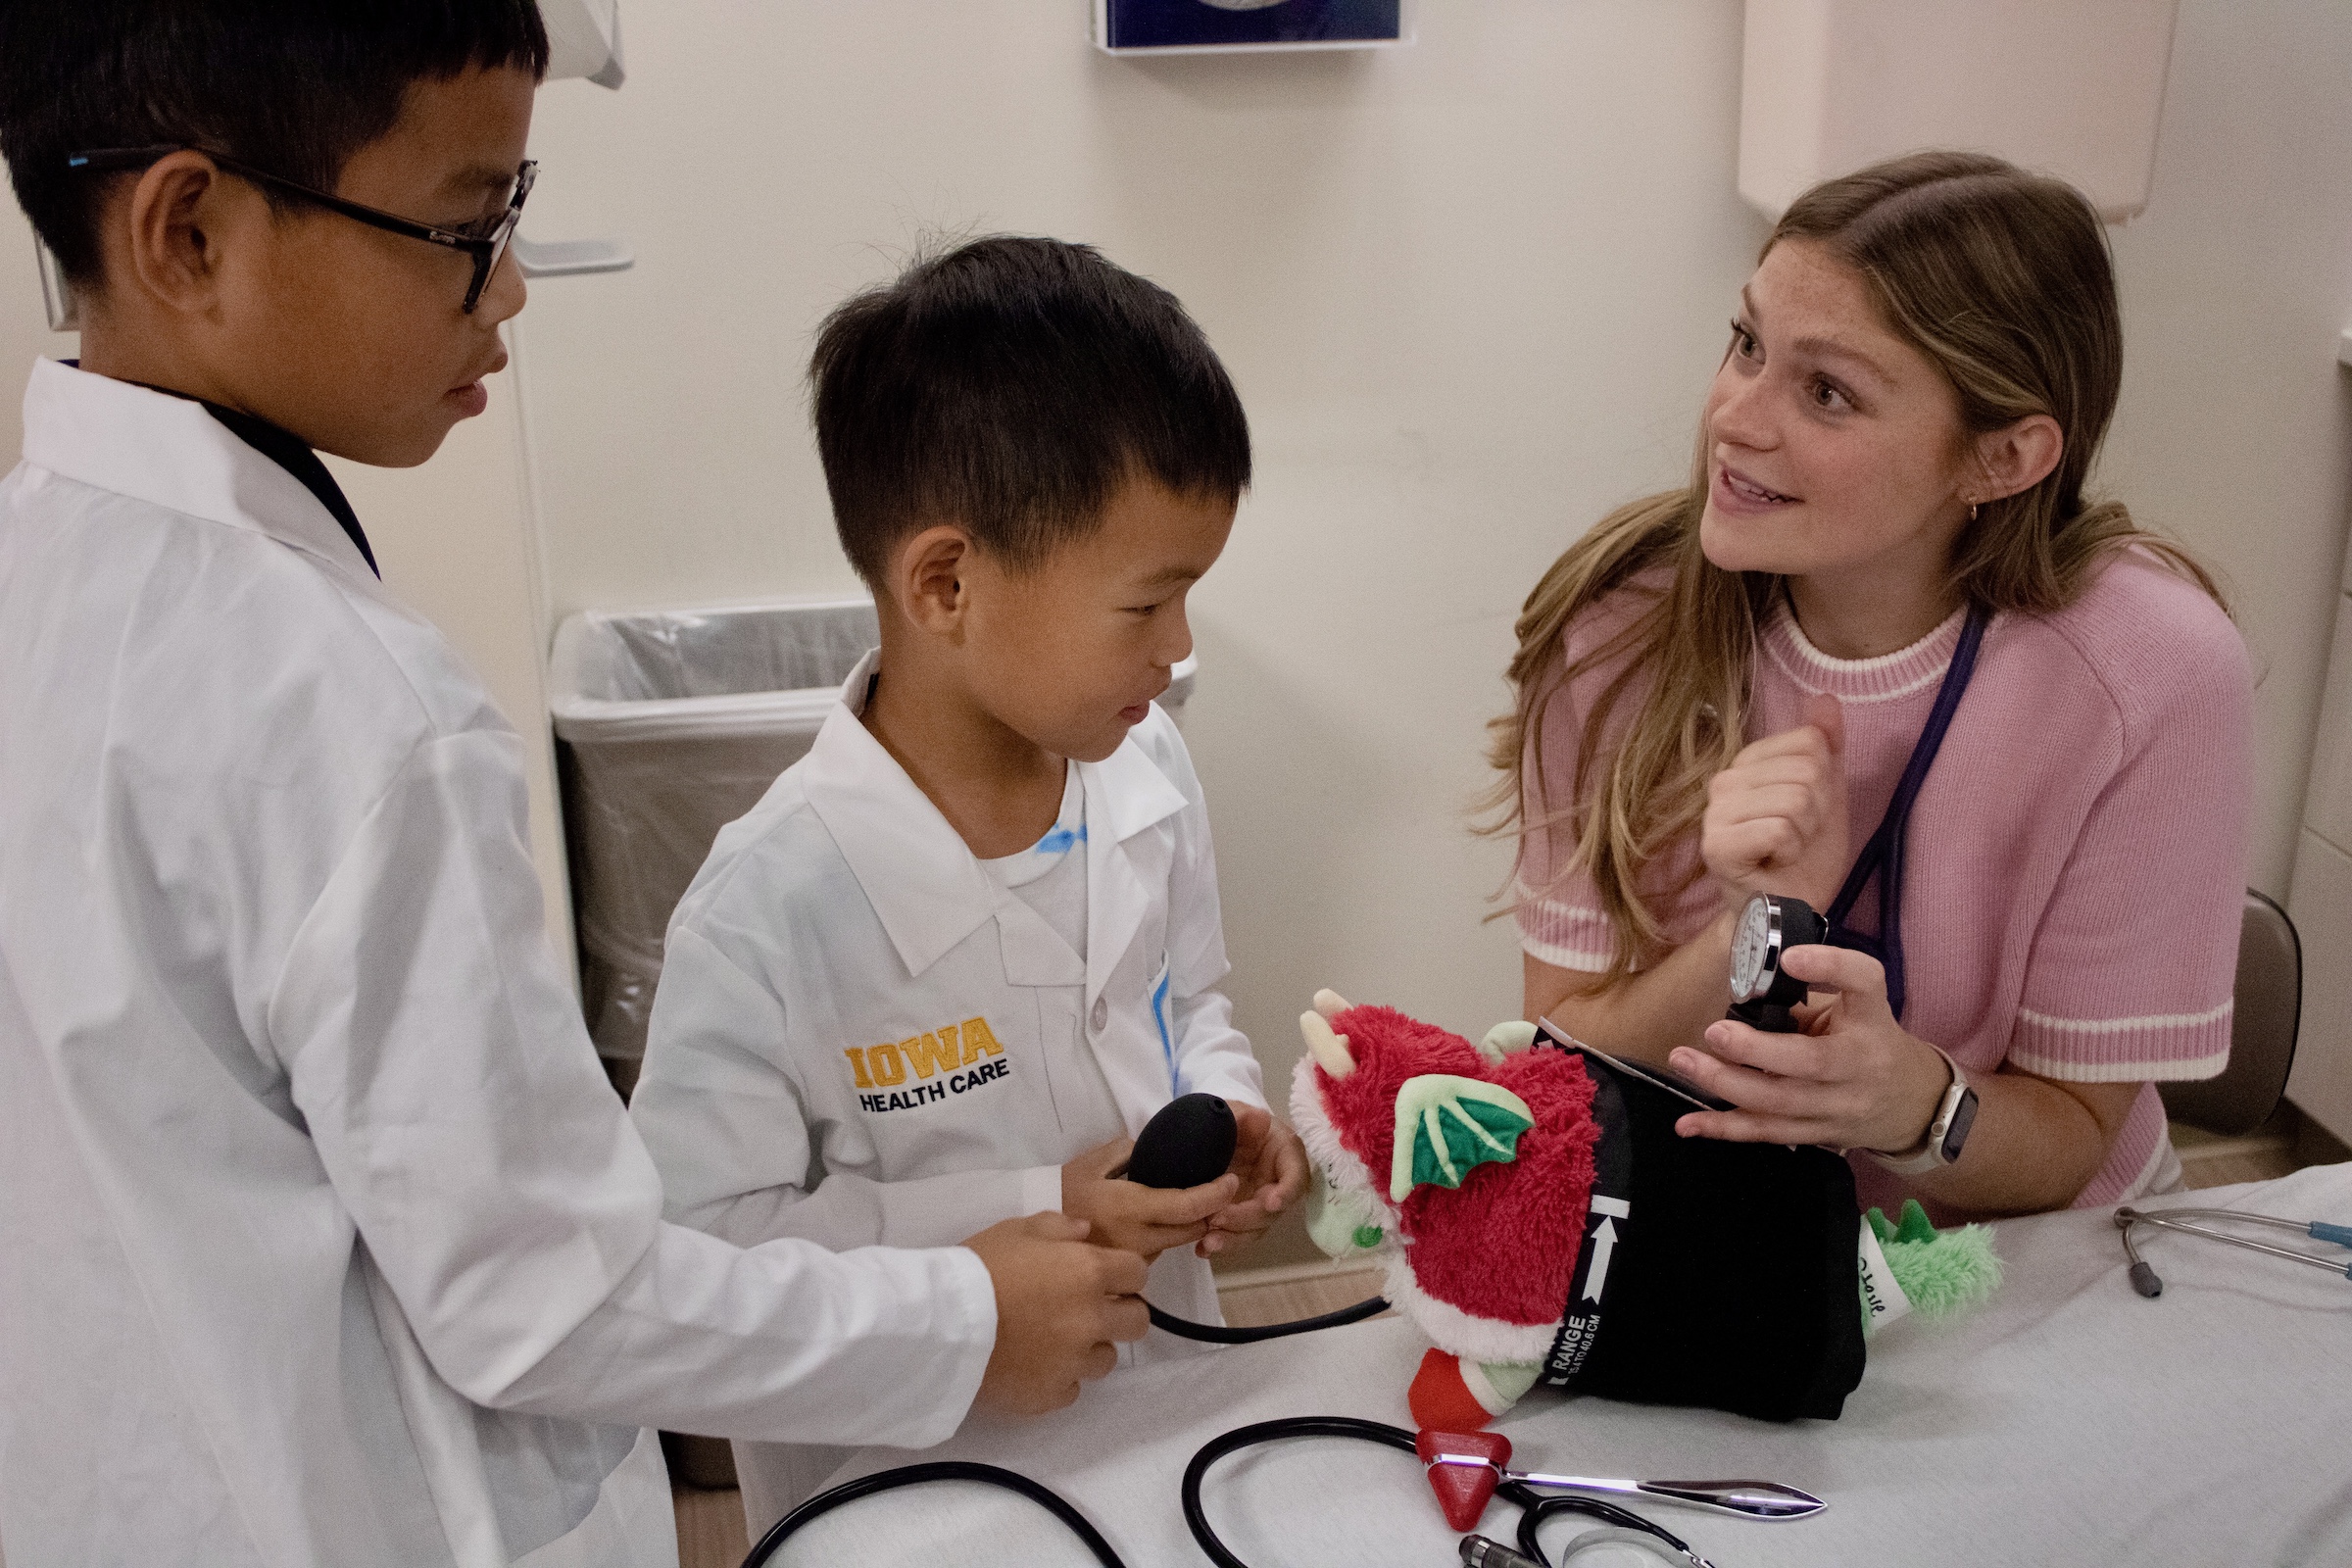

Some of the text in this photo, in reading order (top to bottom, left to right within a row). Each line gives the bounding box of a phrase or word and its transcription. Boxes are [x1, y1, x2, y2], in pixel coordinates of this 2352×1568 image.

[844, 1016, 1004, 1089] IOWA
[859, 1058, 1010, 1112] HEALTH CARE
[1580, 1332, 1594, 1350] 40.6
[1587, 1314, 1600, 1332] CM
[1551, 1315, 1587, 1370] RANGE
[1574, 1350, 1587, 1361] TO
